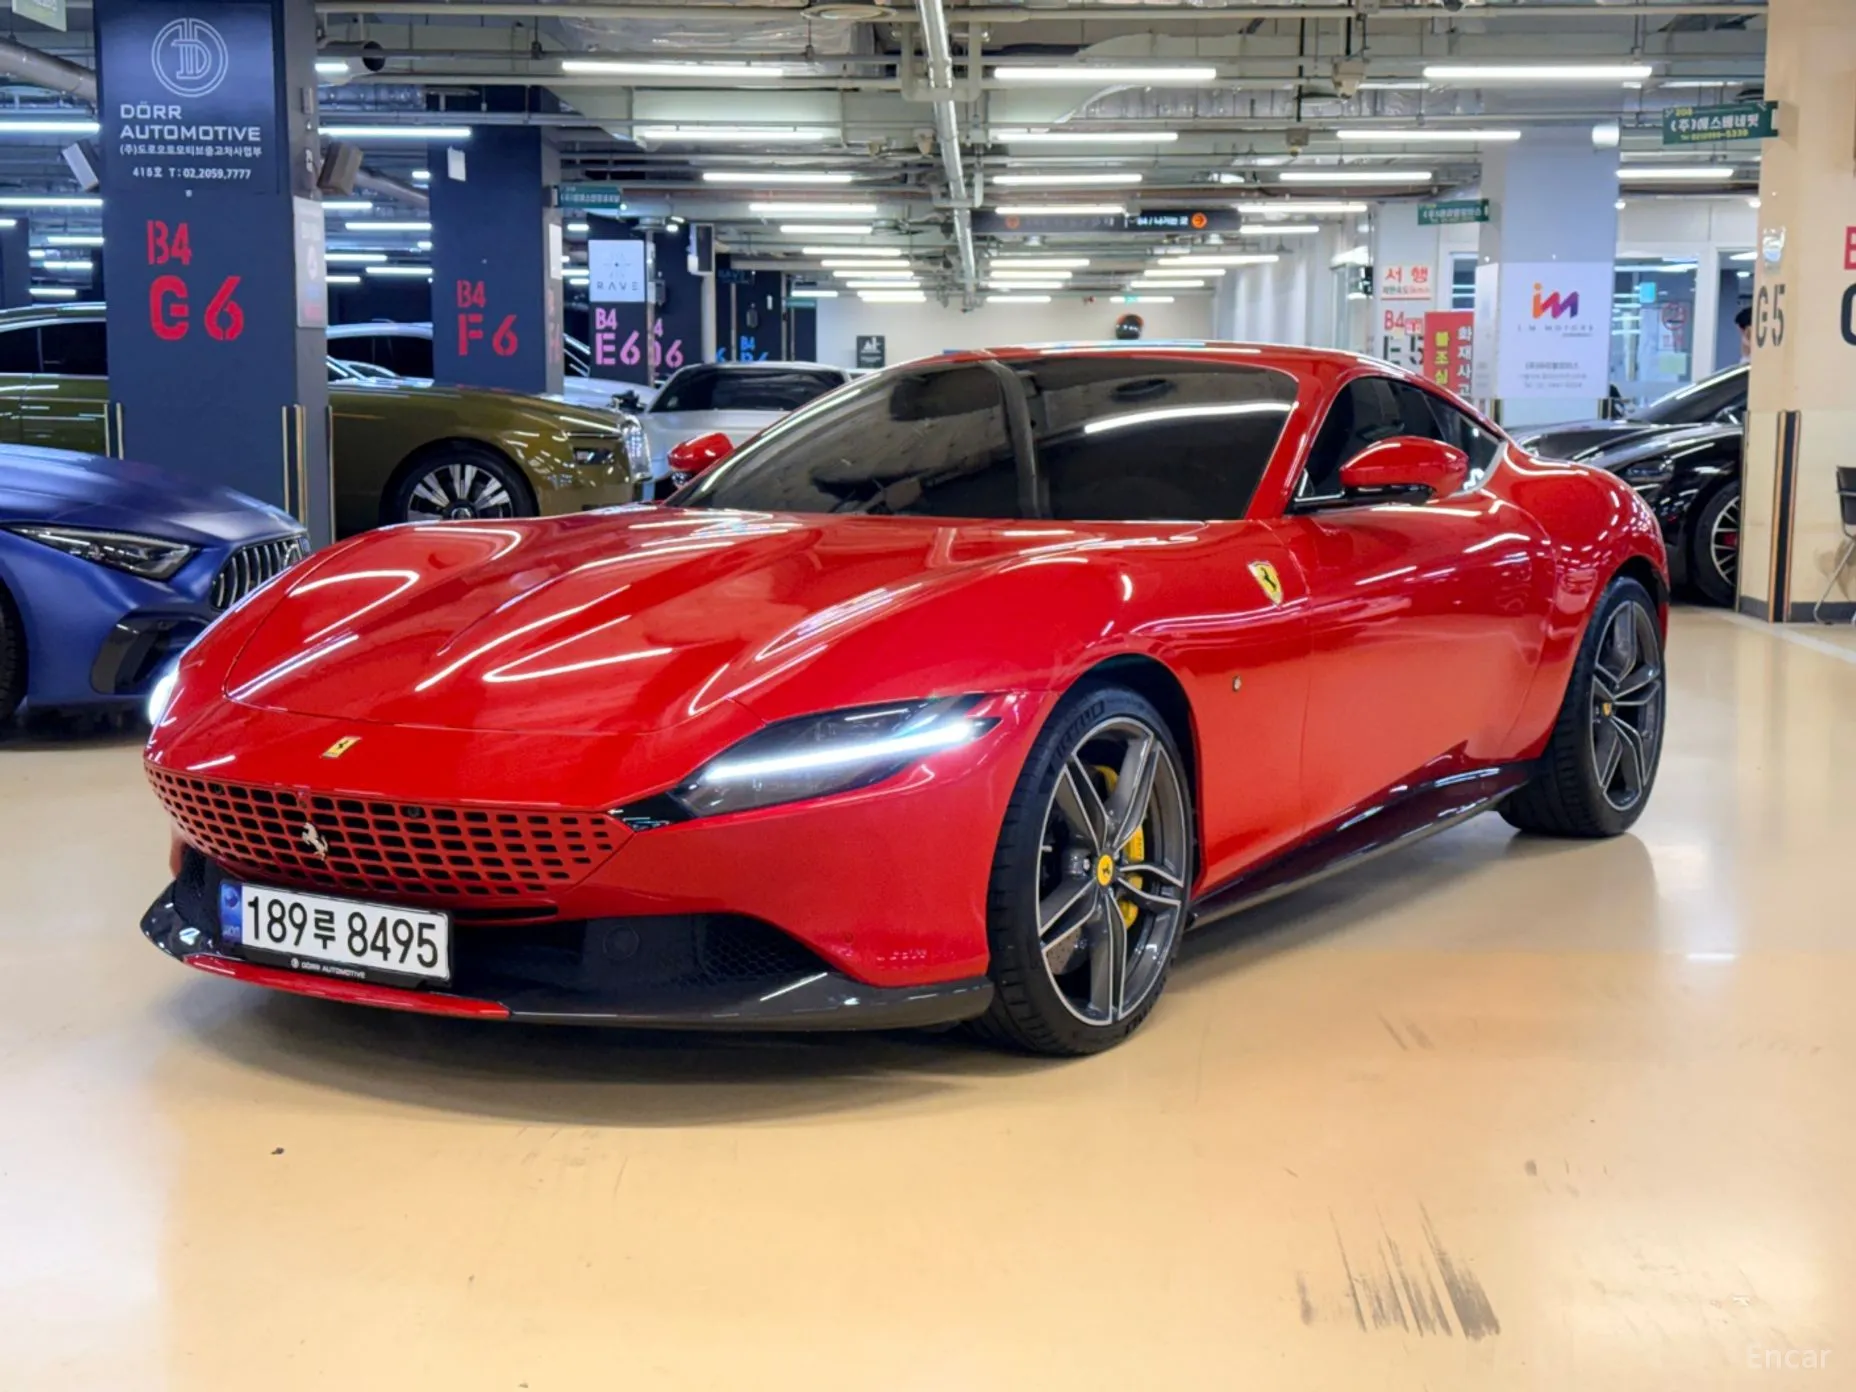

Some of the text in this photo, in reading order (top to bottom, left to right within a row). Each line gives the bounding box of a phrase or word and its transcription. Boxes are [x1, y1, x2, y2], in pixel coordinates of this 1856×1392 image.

[120, 101, 182, 120] DÖRR
[120, 125, 261, 142] AUTOMOTIVE
[147, 219, 192, 265] B4
[456, 280, 486, 308] B4
[597, 281, 639, 291] RAVE
[595, 307, 618, 330] B4
[1384, 309, 1405, 331] B4
[595, 330, 641, 366] E6
[248, 895, 438, 968] 189루 8495
